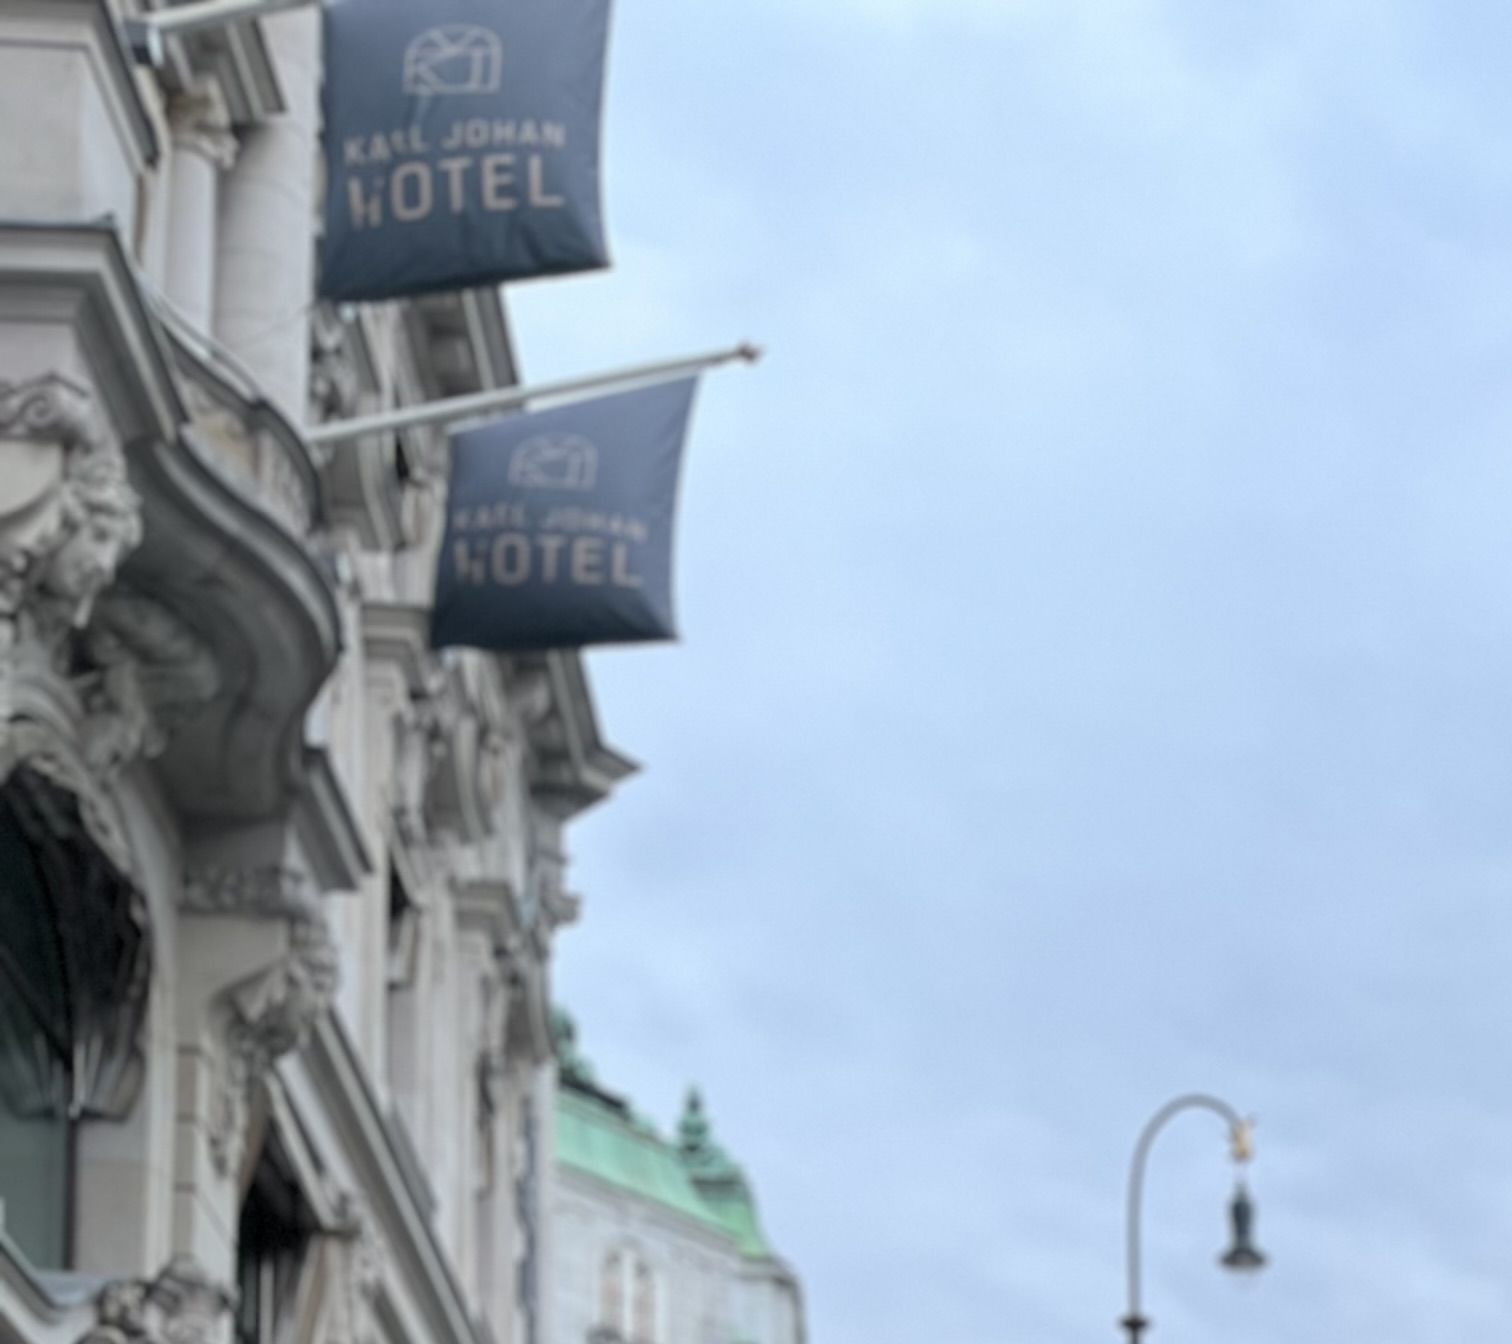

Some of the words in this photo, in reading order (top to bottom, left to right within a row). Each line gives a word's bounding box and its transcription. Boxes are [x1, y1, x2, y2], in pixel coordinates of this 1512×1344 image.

[442, 119, 566, 150] JOHAN
[348, 154, 566, 228] HOTEL
[453, 533, 645, 587] HOTEL
